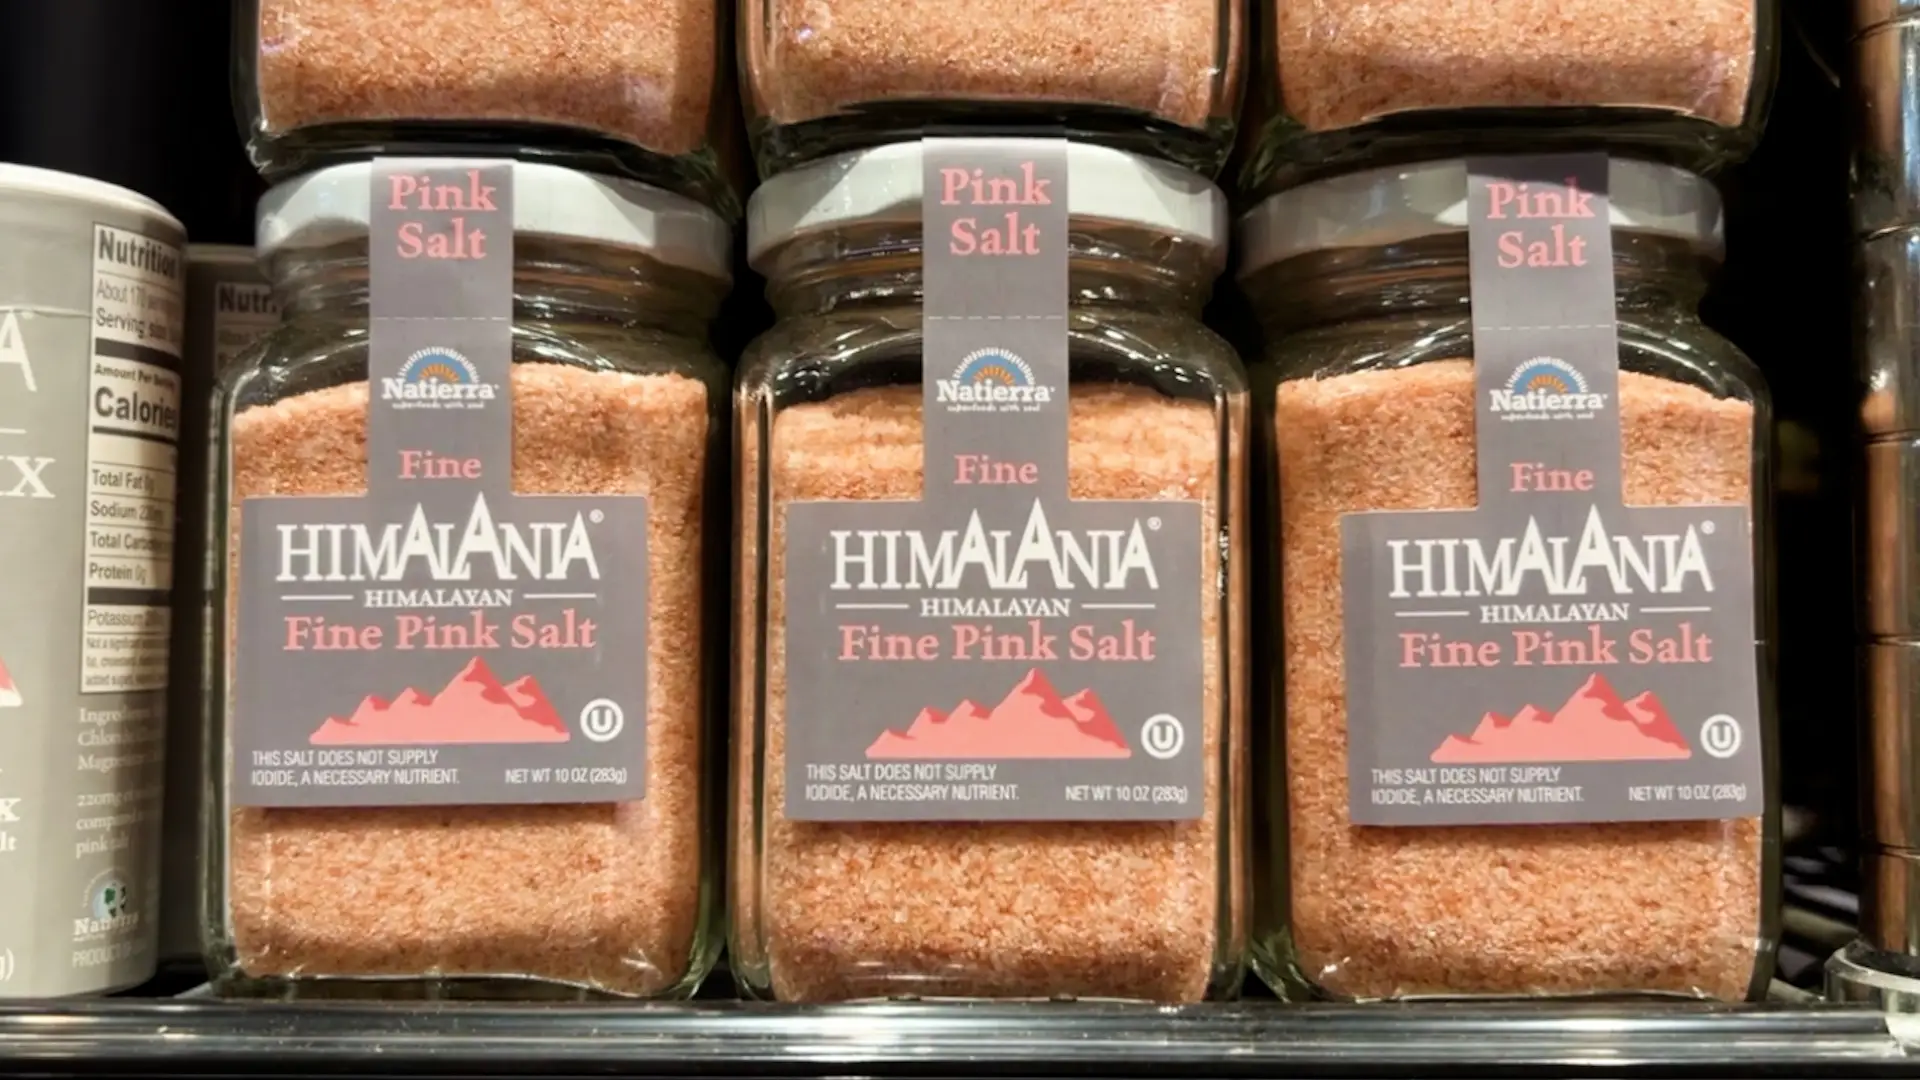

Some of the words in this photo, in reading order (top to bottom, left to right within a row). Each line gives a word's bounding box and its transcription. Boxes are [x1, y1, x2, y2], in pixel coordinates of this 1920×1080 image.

[388, 169, 498, 211] Pink
[940, 161, 1052, 206] Pink
[1485, 175, 1595, 219] Pink
[397, 217, 488, 260] Salt
[949, 211, 1041, 256] Salt
[100, 229, 178, 280] Nutrition
[1497, 224, 1587, 268] Salt
[96, 307, 145, 339] Serving
[94, 363, 137, 381] Amount
[381, 377, 497, 399] Natierra
[936, 378, 1051, 402] Natierra
[95, 386, 178, 431] Calories
[1489, 388, 1604, 411] Natierra
[398, 449, 482, 479] Fine
[953, 454, 1039, 485] Fine
[92, 469, 122, 487] Total
[126, 472, 142, 490] Fat
[1509, 462, 1595, 493] Fine
[90, 500, 137, 519] Sodium
[89, 531, 121, 549] Total
[89, 561, 132, 580] Protein
[364, 589, 515, 609] HIMALAYAN
[920, 598, 1071, 618] HIMALAYAN
[1480, 602, 1630, 624] HIMALAYAN
[283, 615, 383, 651] Fine
[394, 610, 500, 651] Pink
[511, 608, 597, 650] Salt
[837, 625, 940, 662] Fine
[951, 619, 1058, 661] Pink
[1069, 619, 1157, 661] Salt
[1398, 631, 1500, 669] Fine
[1512, 624, 1619, 667] Pink
[1629, 623, 1713, 665] Salt
[252, 750, 281, 766] THIS
[284, 750, 313, 766] SALT
[318, 750, 354, 766] DOES
[357, 750, 384, 766] NOT
[387, 749, 439, 766] SUPPLY
[252, 770, 298, 788] IODIDE,
[300, 770, 311, 785] A
[313, 769, 393, 786] NECESSARY
[394, 768, 460, 785] NUTRIENT.
[505, 768, 528, 784] NET
[531, 768, 551, 783] WT
[555, 768, 569, 783] 10
[571, 768, 588, 783] OZ
[589, 767, 628, 785] (283g)
[806, 763, 836, 781] THIS
[839, 763, 871, 781] SALT
[874, 763, 911, 780] DOES
[914, 763, 942, 780] NOT
[945, 763, 997, 780] SUPPLY
[1371, 768, 1402, 785] THIS
[1405, 768, 1437, 785] SALT
[1440, 767, 1476, 784] DOES
[1479, 767, 1507, 784] NOT
[1510, 766, 1562, 784] SUPPLY
[805, 784, 855, 802] IODIDE,
[857, 784, 868, 800] A
[869, 784, 949, 801] NECESSARY
[951, 784, 1020, 800] NUTRIENT.
[1065, 785, 1089, 801] NET
[1092, 785, 1111, 801] WT
[1115, 786, 1130, 801] 10
[1133, 785, 1150, 801] OZ
[1152, 785, 1188, 804] (283g)
[1371, 788, 1422, 806] IODIDE,
[1424, 788, 1434, 804] A
[1436, 788, 1515, 804] NECESSARY
[1517, 786, 1585, 802] NUTRIENT.
[1628, 785, 1651, 801] NET
[1654, 785, 1674, 801] WT
[1676, 785, 1690, 800] 10
[1693, 784, 1711, 800] OZ
[1712, 783, 1747, 802] (283g)
